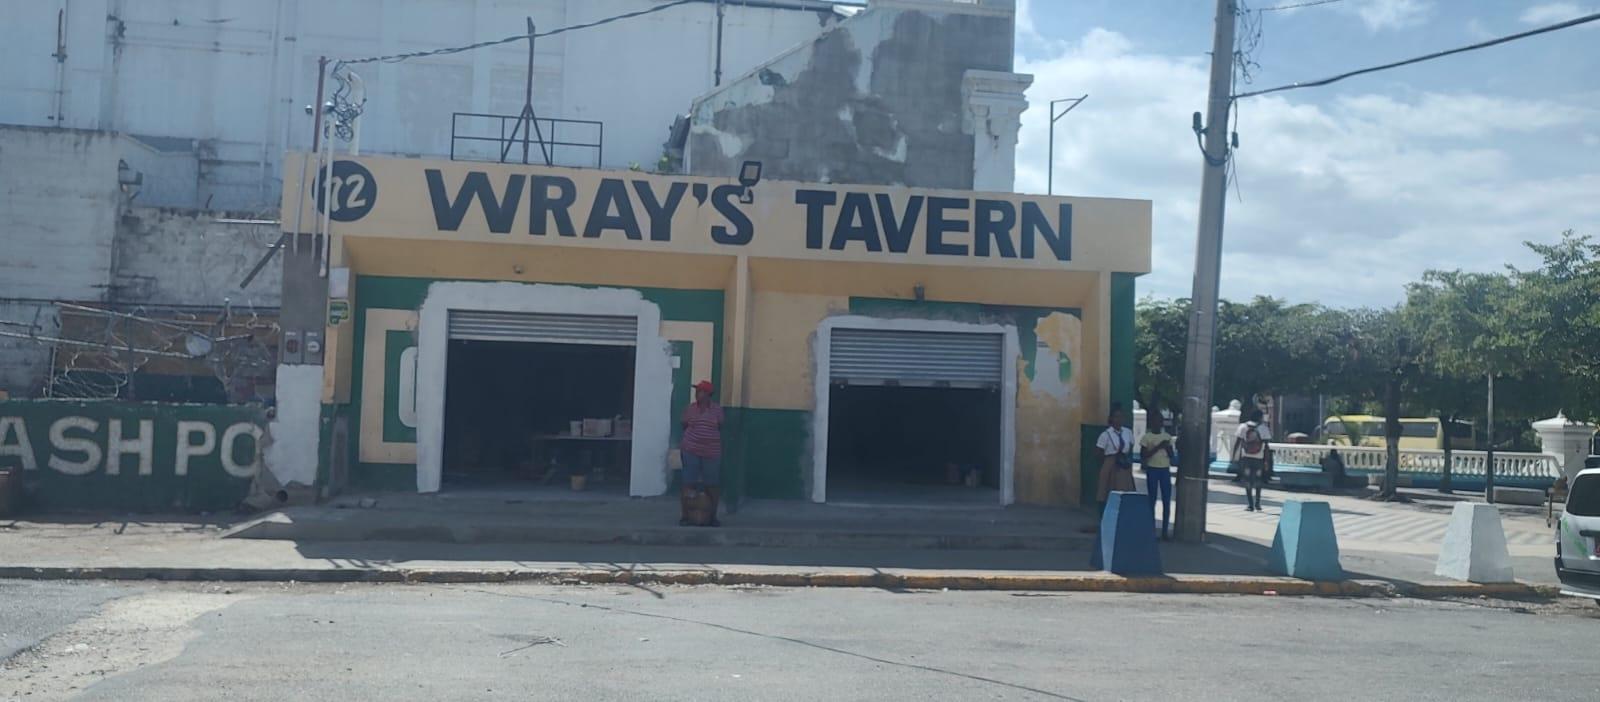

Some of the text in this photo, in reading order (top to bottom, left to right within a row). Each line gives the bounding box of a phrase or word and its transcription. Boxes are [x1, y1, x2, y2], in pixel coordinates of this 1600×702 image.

[425, 169, 1073, 262] WRAY'S TAVERN
[174, 420, 264, 478] PO
